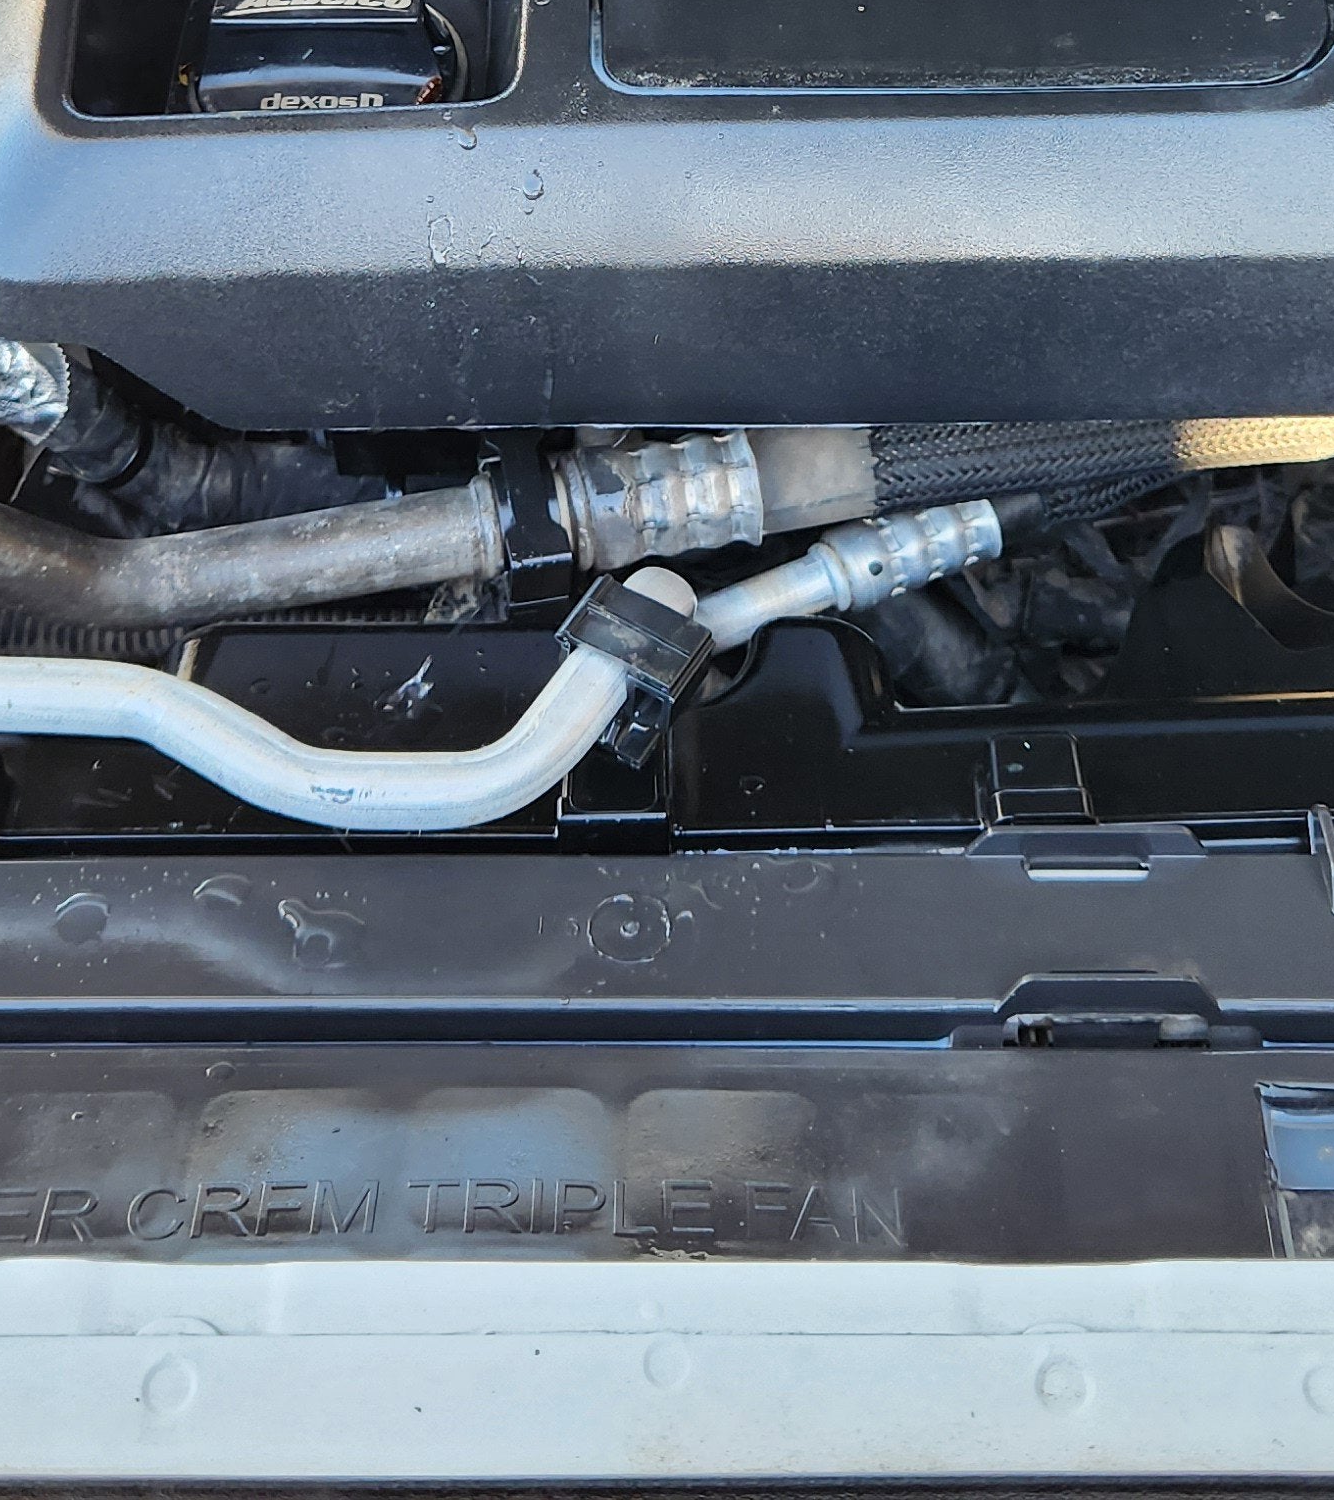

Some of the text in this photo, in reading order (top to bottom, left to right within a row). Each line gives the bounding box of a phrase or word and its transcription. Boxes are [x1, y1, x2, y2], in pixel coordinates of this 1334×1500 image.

[127, 1178, 380, 1240] CRFM
[408, 1177, 714, 1237] TRIPLE
[745, 1181, 906, 1249] FAN
